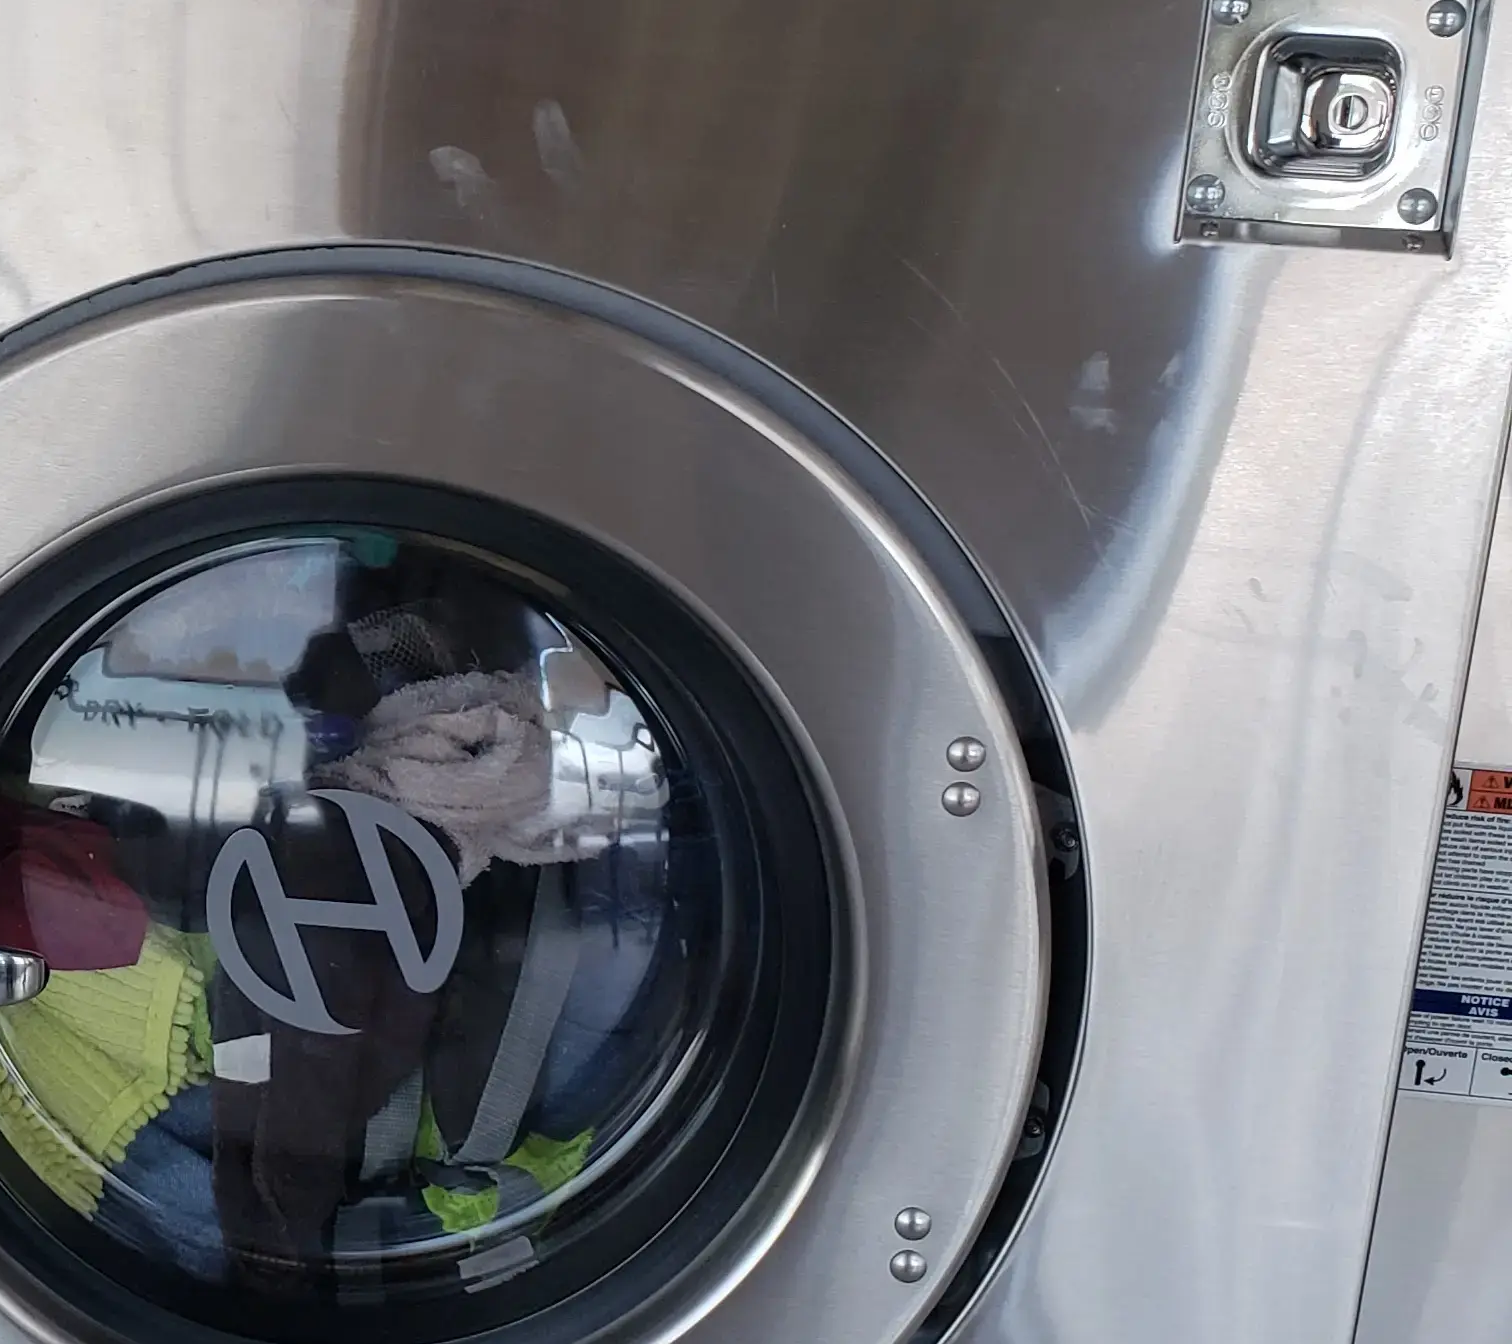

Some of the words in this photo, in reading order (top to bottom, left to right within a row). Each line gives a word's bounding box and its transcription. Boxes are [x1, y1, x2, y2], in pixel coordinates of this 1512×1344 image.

[1460, 994, 1510, 1008] NOTICE
[1468, 1006, 1499, 1017] AVIS
[1405, 1046, 1468, 1059] pen/Ouverte
